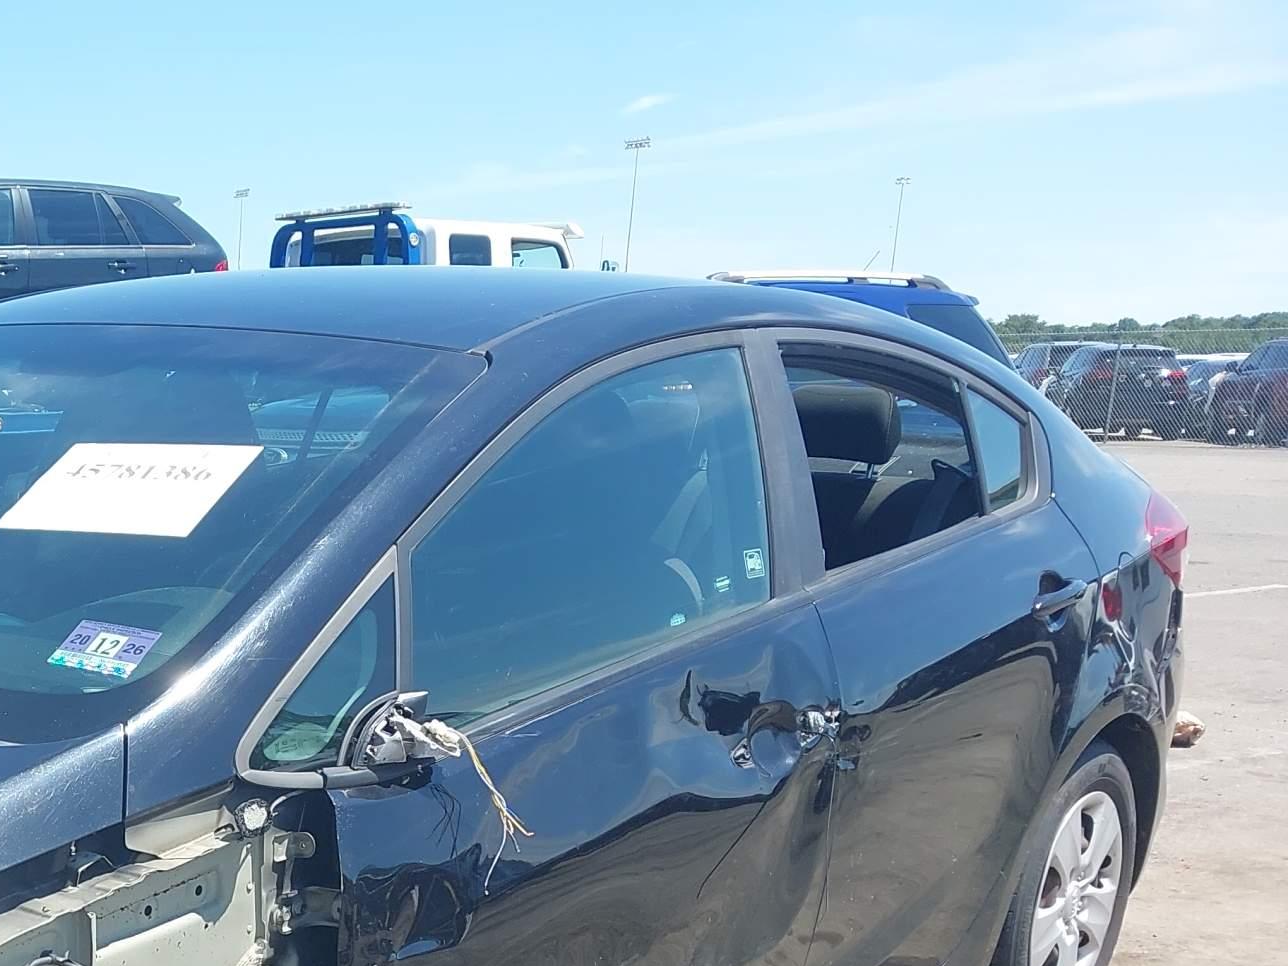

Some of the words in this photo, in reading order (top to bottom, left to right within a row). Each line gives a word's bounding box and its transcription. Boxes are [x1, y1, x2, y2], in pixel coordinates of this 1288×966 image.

[65, 463, 213, 481] 45781386
[70, 633, 91, 646] 20
[91, 637, 120, 656] 12
[123, 643, 146, 656] 26
